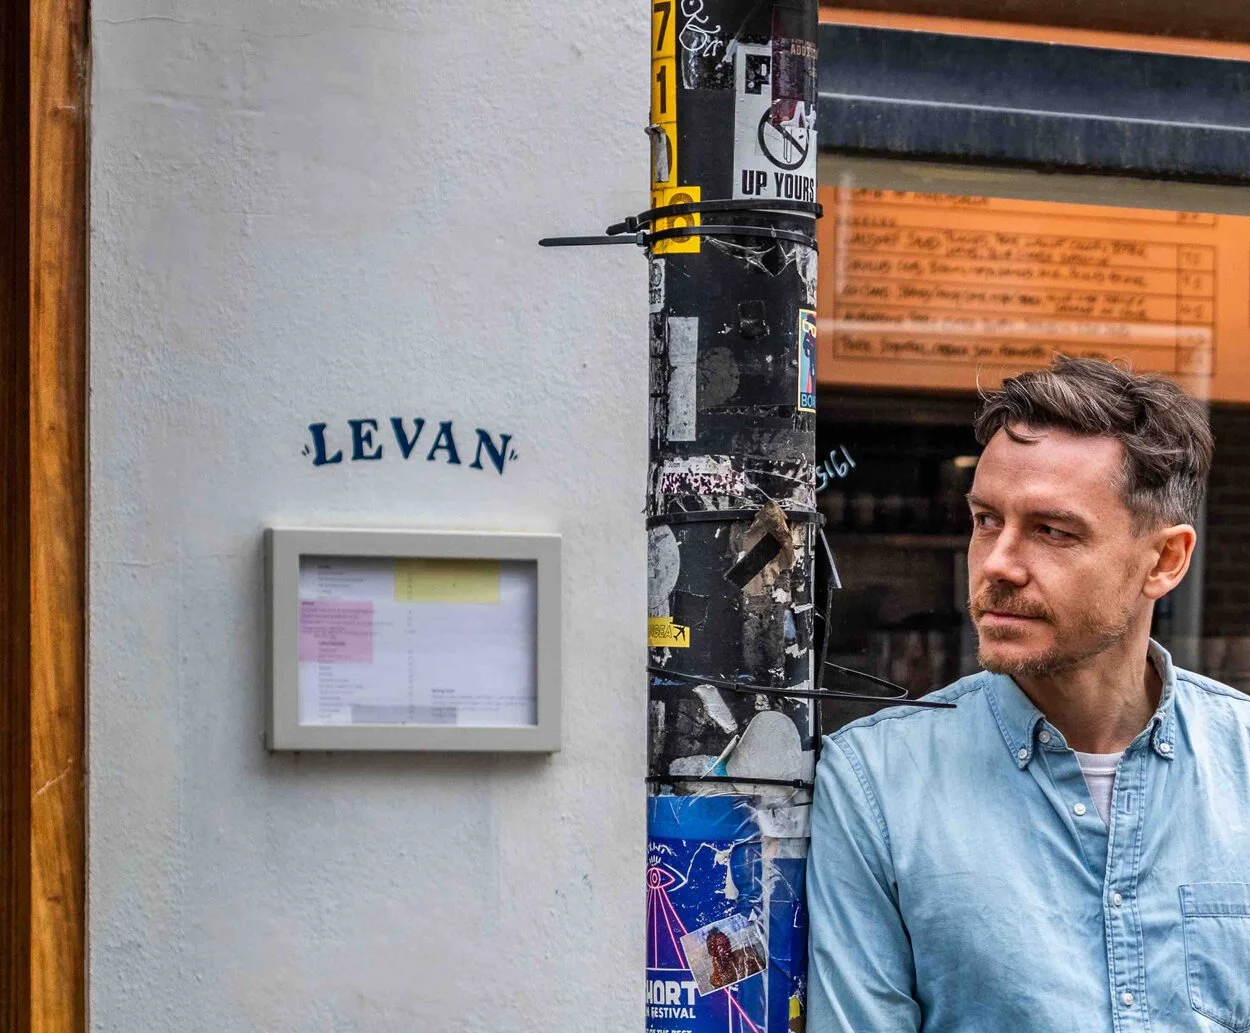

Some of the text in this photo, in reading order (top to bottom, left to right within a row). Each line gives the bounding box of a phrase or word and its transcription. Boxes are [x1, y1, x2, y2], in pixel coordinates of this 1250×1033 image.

[741, 169, 815, 202] UP YOURS
[306, 416, 514, 475] LEVAN
[651, 1006, 697, 1019] FESTIVAL
